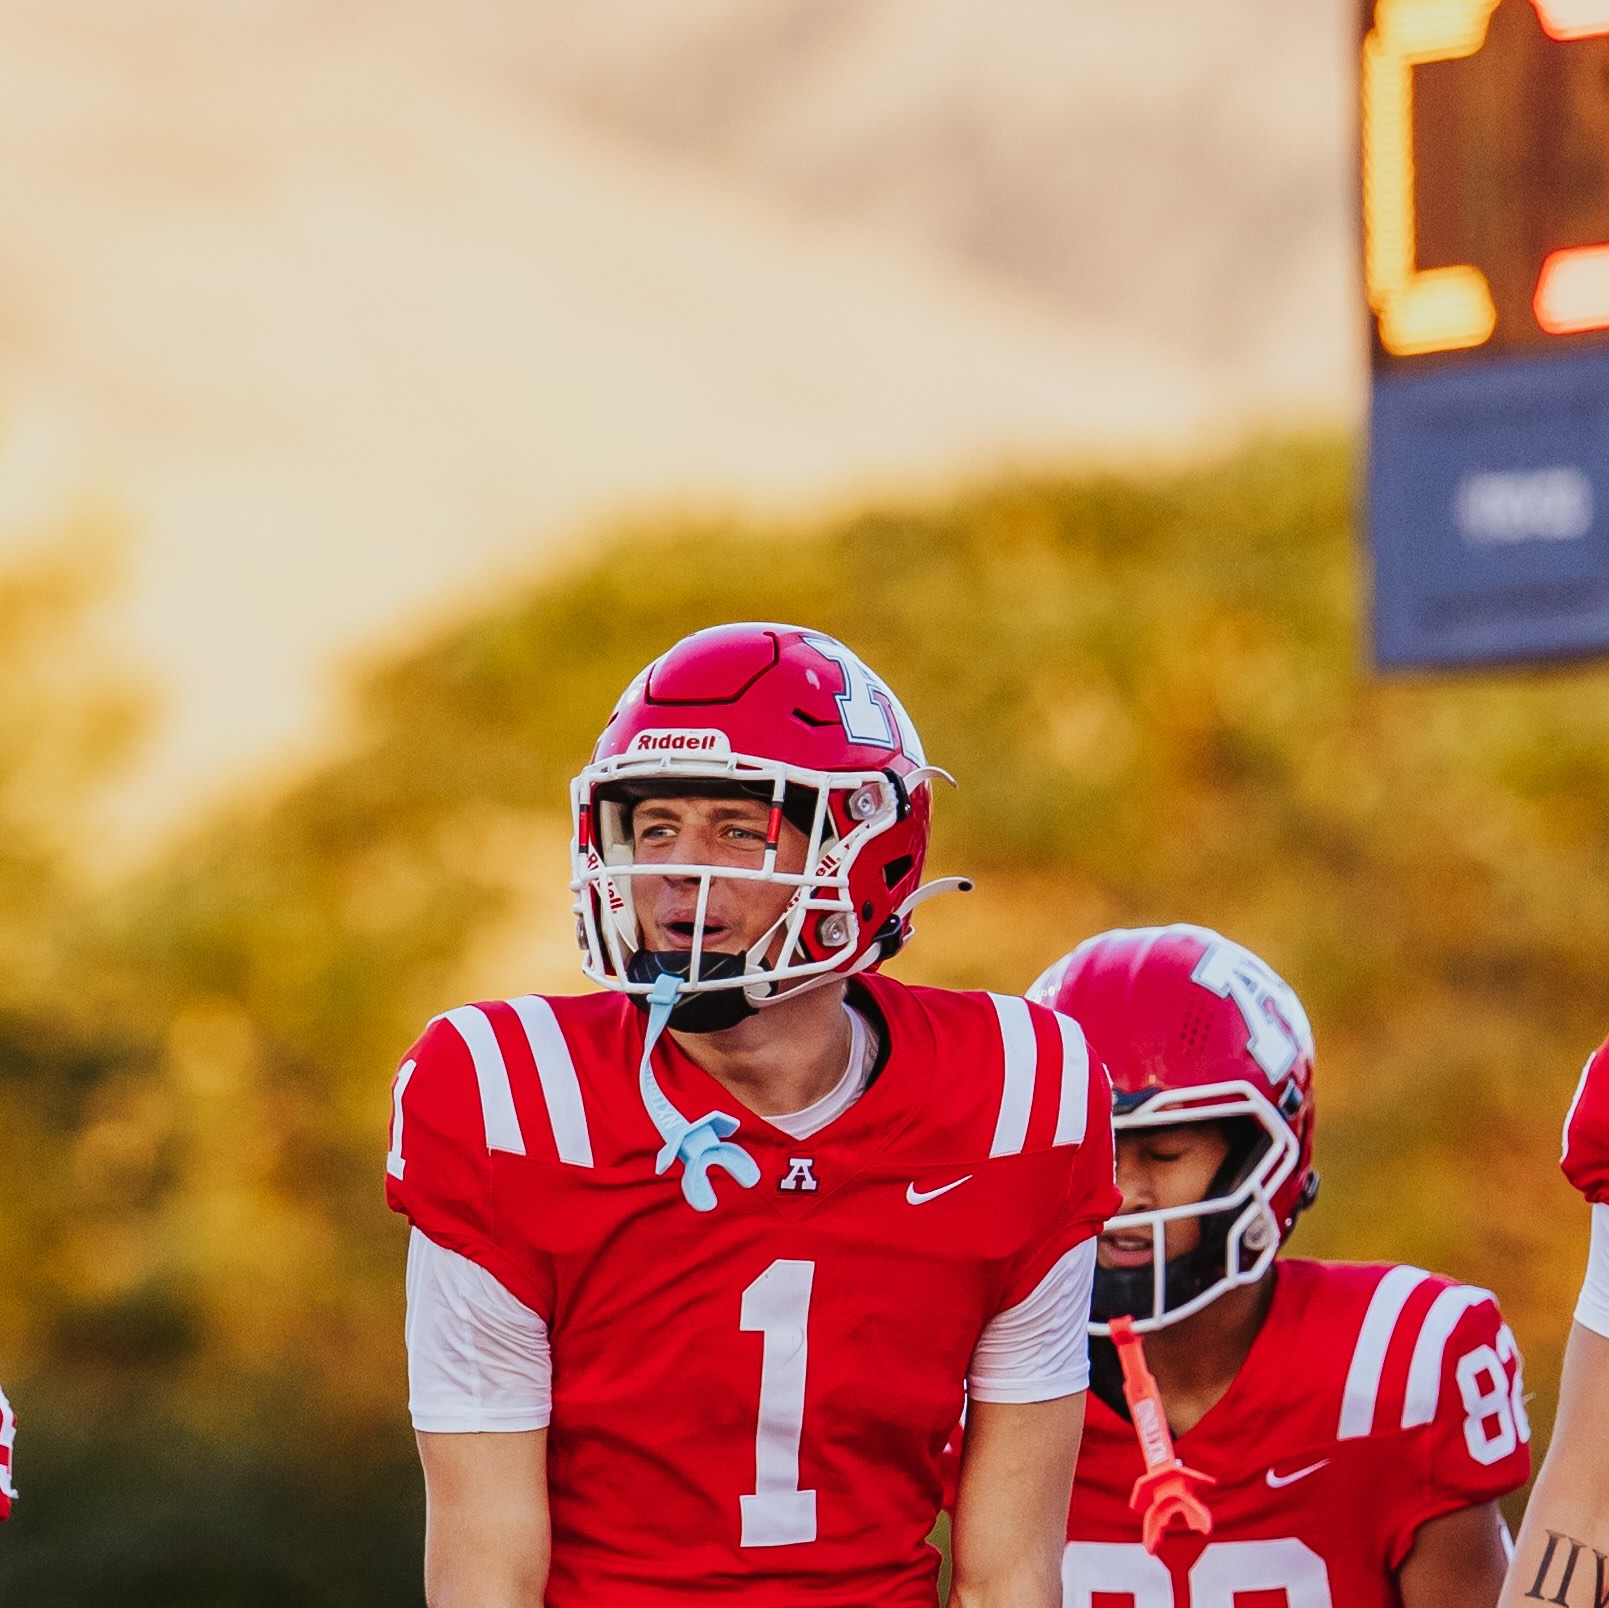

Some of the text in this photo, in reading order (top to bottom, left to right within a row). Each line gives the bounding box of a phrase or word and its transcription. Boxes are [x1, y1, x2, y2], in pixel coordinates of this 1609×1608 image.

[637, 734, 717, 751] Riddell
[780, 1157, 817, 1190] A
[739, 1259, 818, 1548] 1
